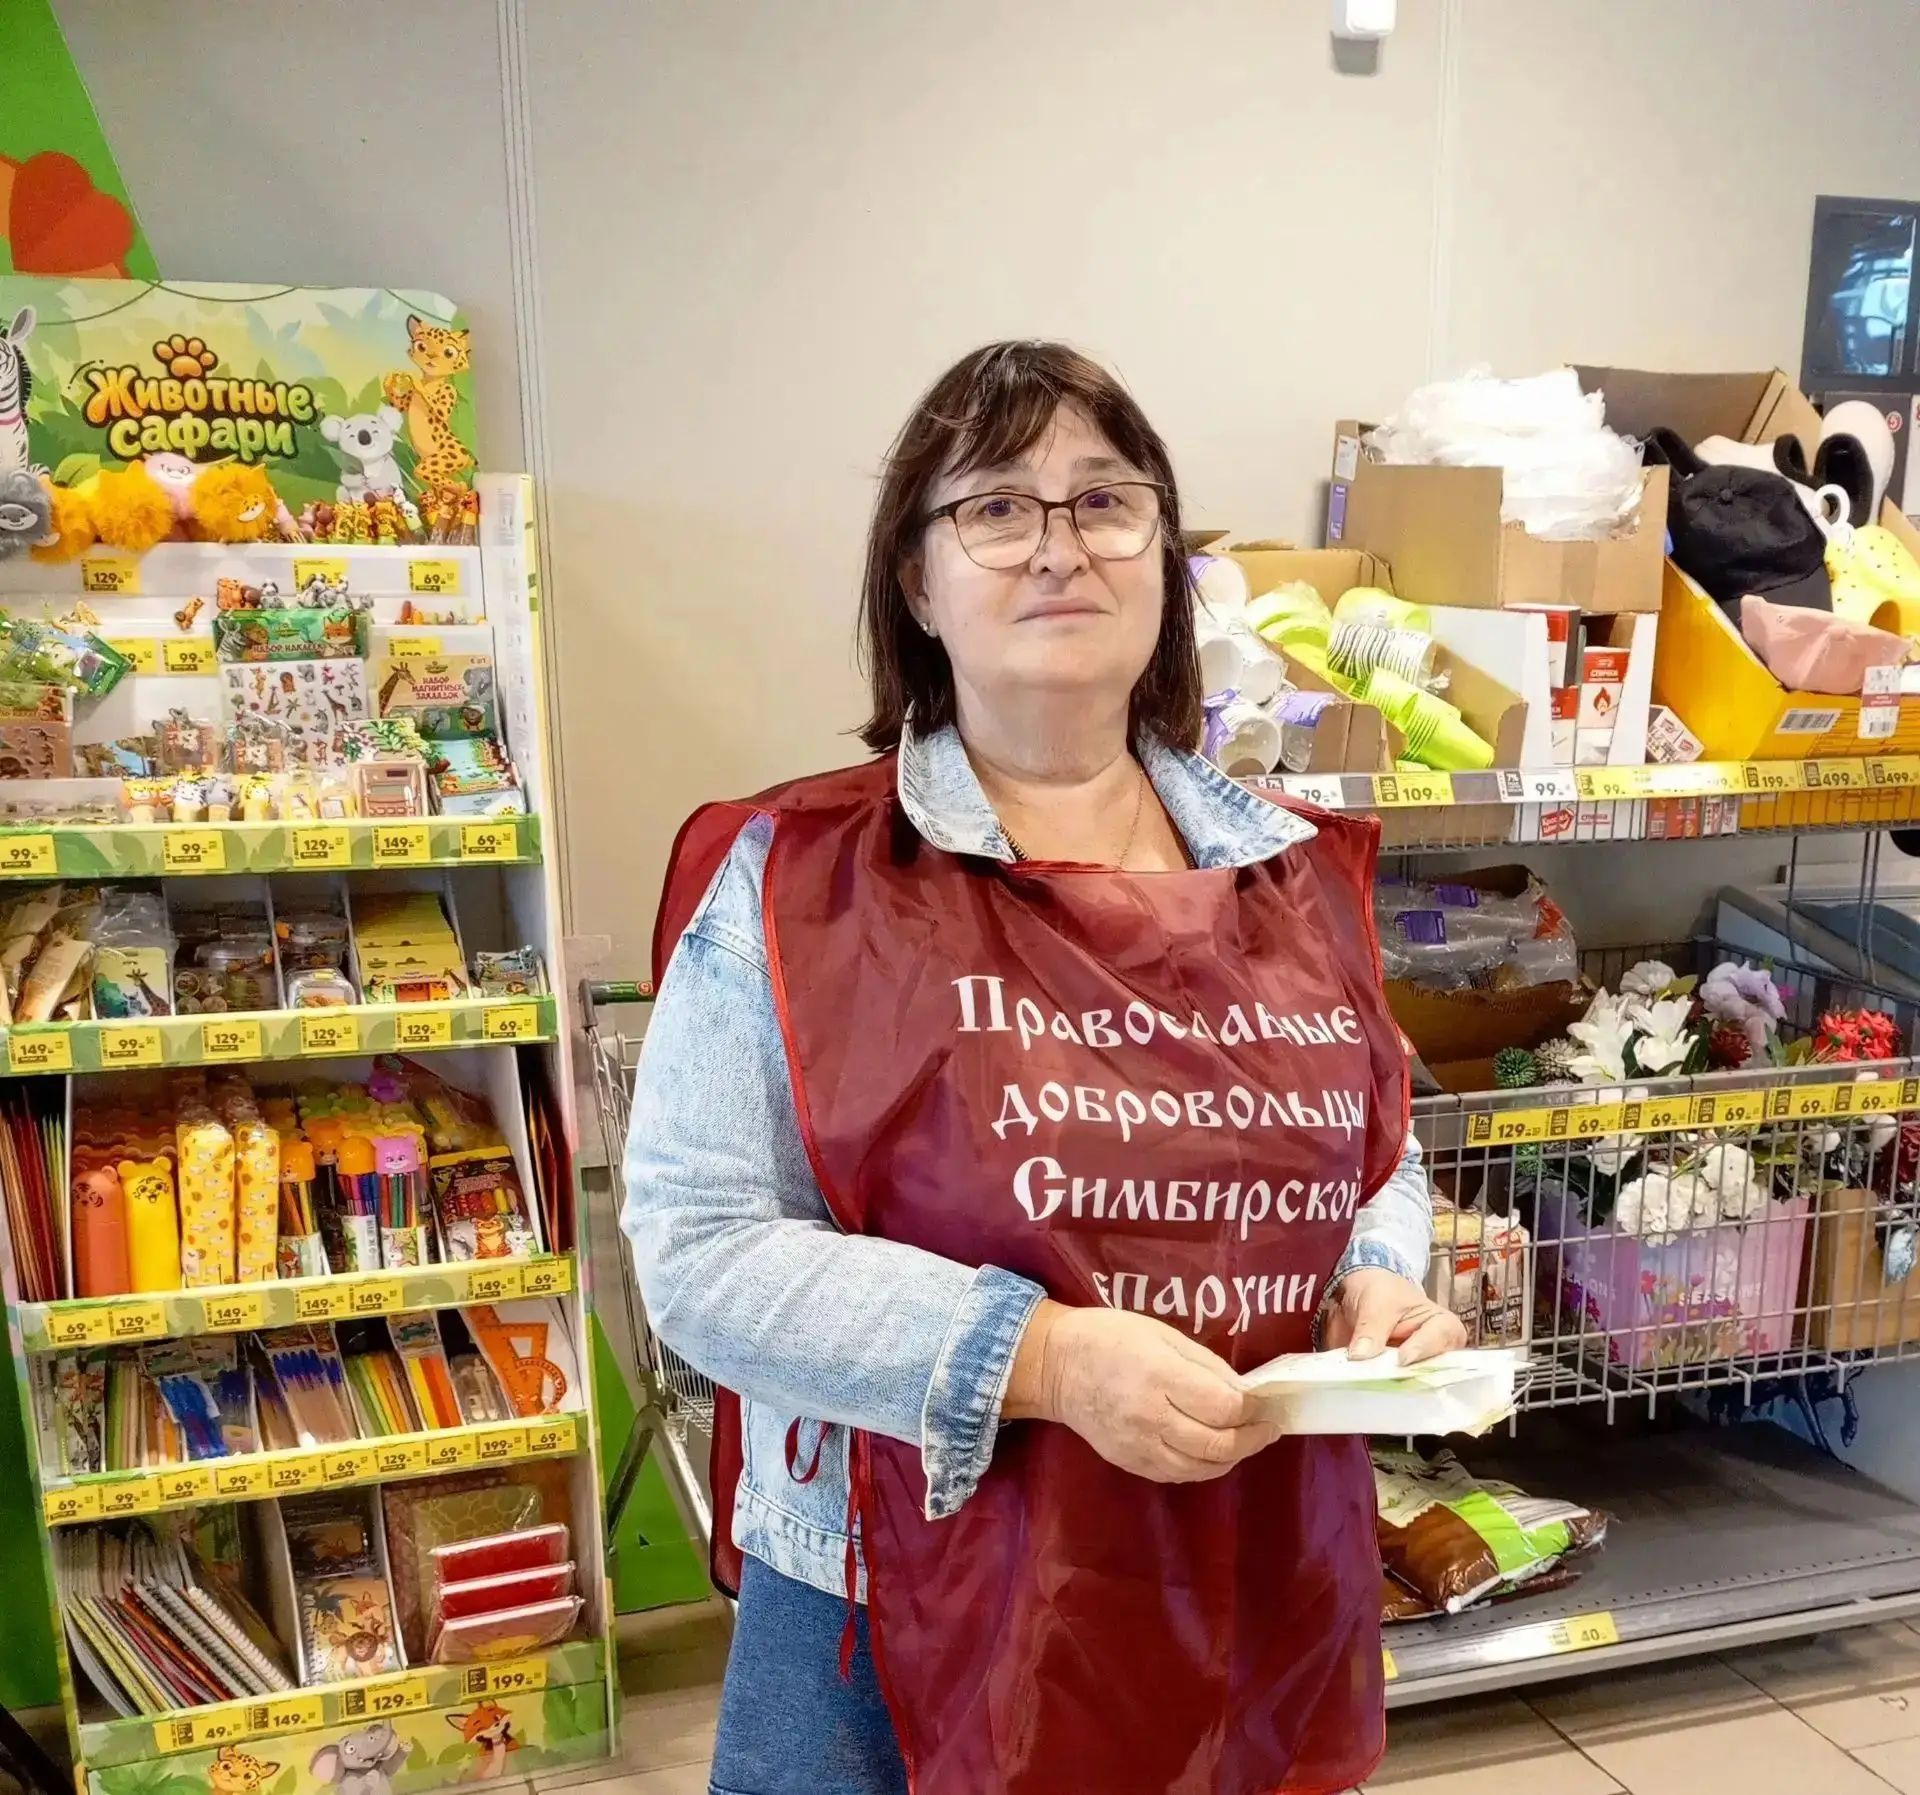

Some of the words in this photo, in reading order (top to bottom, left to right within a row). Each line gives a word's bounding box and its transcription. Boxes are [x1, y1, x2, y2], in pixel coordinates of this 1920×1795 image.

[86, 366, 315, 423] Животные
[109, 411, 297, 459] сафари
[94, 572, 117, 583] 129
[424, 574, 440, 585] 69
[179, 652, 198, 664] 99
[1762, 776, 1784, 788] 199
[1823, 772, 1850, 786] 499
[1886, 770, 1909, 784] 499
[1402, 787, 1432, 800] 109
[1535, 782, 1556, 796] 99
[1603, 784, 1620, 795] 99
[304, 839, 328, 850] 129
[384, 837, 408, 849] 149
[477, 834, 496, 846] 69
[10, 849, 30, 860] 99
[182, 843, 201, 854] 99
[407, 1024, 430, 1035] 129
[499, 1020, 516, 1031] 69
[214, 1033, 238, 1044] 129
[313, 1028, 336, 1039] 129
[20, 1044, 47, 1055] 149
[118, 1038, 138, 1049] 99
[1800, 1100, 1820, 1114] 69
[1861, 1095, 1881, 1109] 69
[991, 1081, 1365, 1142] добровольцы
[1725, 1107, 1745, 1121] 69
[1578, 1118, 1599, 1133] 69
[1651, 1113, 1671, 1127] 69
[1498, 1123, 1526, 1138] 129
[534, 1273, 551, 1285] 69
[477, 1280, 501, 1291] 149
[305, 1298, 329, 1309] 149
[358, 1292, 382, 1304] 149
[216, 1308, 241, 1319] 149
[66, 1322, 86, 1334] 69
[119, 1316, 144, 1328] 129
[540, 1432, 556, 1444] 69
[483, 1439, 508, 1451] 199
[440, 1446, 457, 1458] 69
[383, 1453, 406, 1465] 129
[336, 1460, 354, 1472] 69
[229, 1475, 247, 1486] 99
[277, 1469, 300, 1480] 129
[175, 1480, 193, 1492] 69
[115, 1492, 134, 1504] 99
[57, 1500, 76, 1511] 69
[493, 1673, 525, 1689] 199
[372, 1694, 404, 1711] 129
[273, 1713, 300, 1727] 149
[205, 1726, 226, 1739] 49
